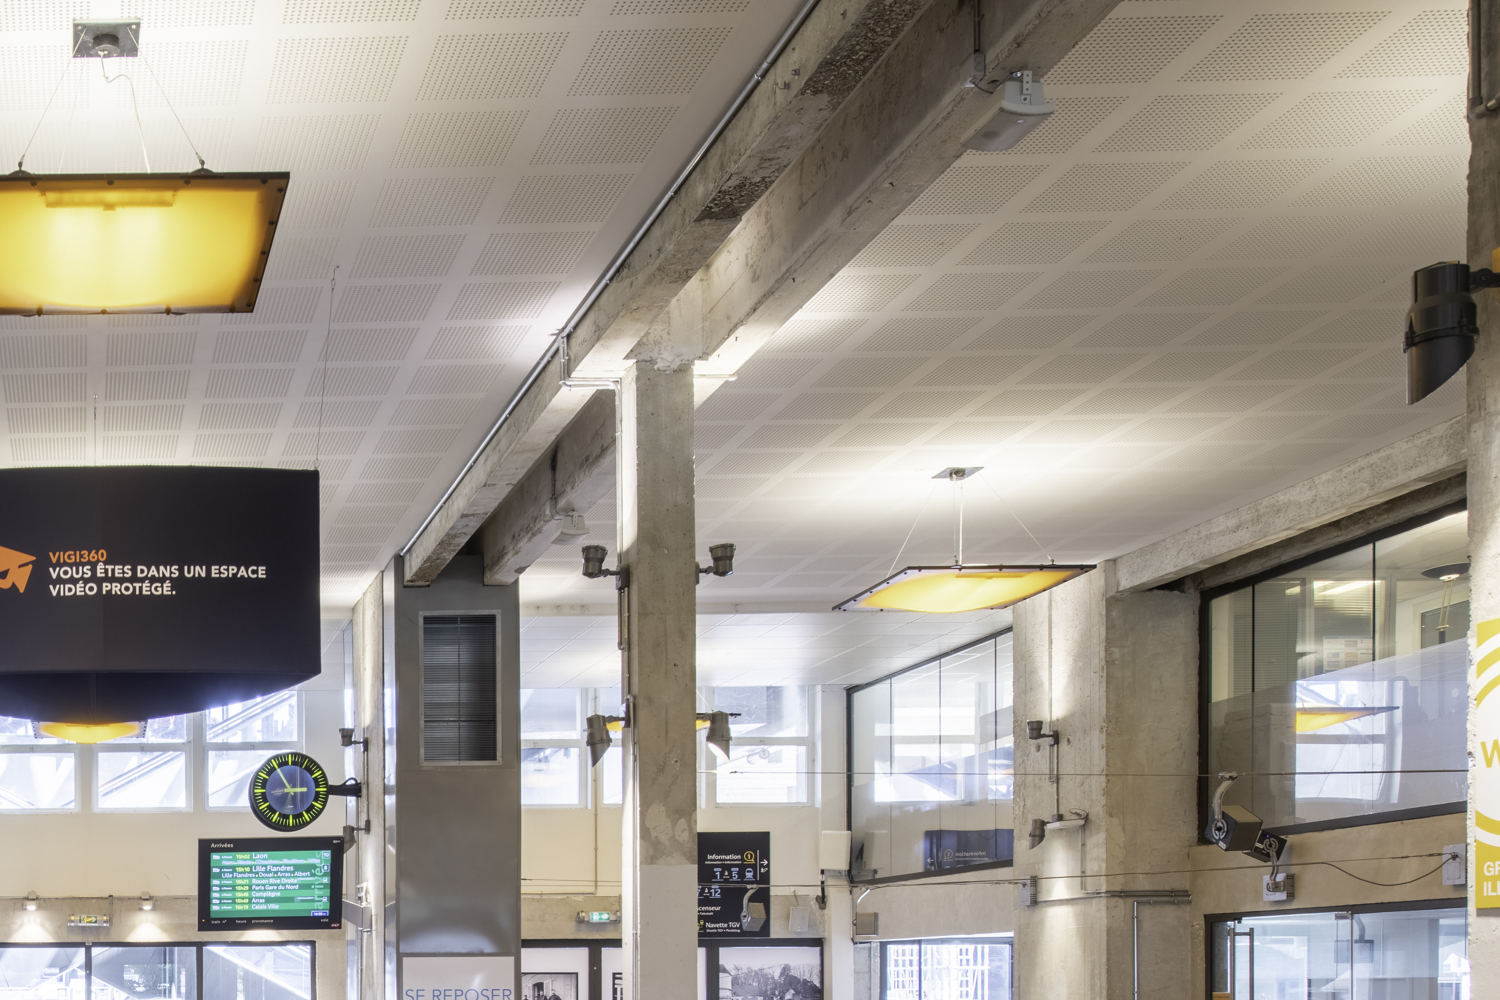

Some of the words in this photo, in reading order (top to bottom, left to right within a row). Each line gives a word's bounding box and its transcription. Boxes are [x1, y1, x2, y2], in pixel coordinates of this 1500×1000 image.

[49, 550, 107, 564] VIGI360
[49, 567, 92, 579] VOUS
[96, 562, 132, 578] ÊTES
[138, 566, 180, 578] DANS
[184, 565, 206, 578] UN
[211, 566, 266, 578] ESPACE
[49, 581, 98, 596] VIDÉO
[102, 579, 176, 595] PROTÉGÉ.
